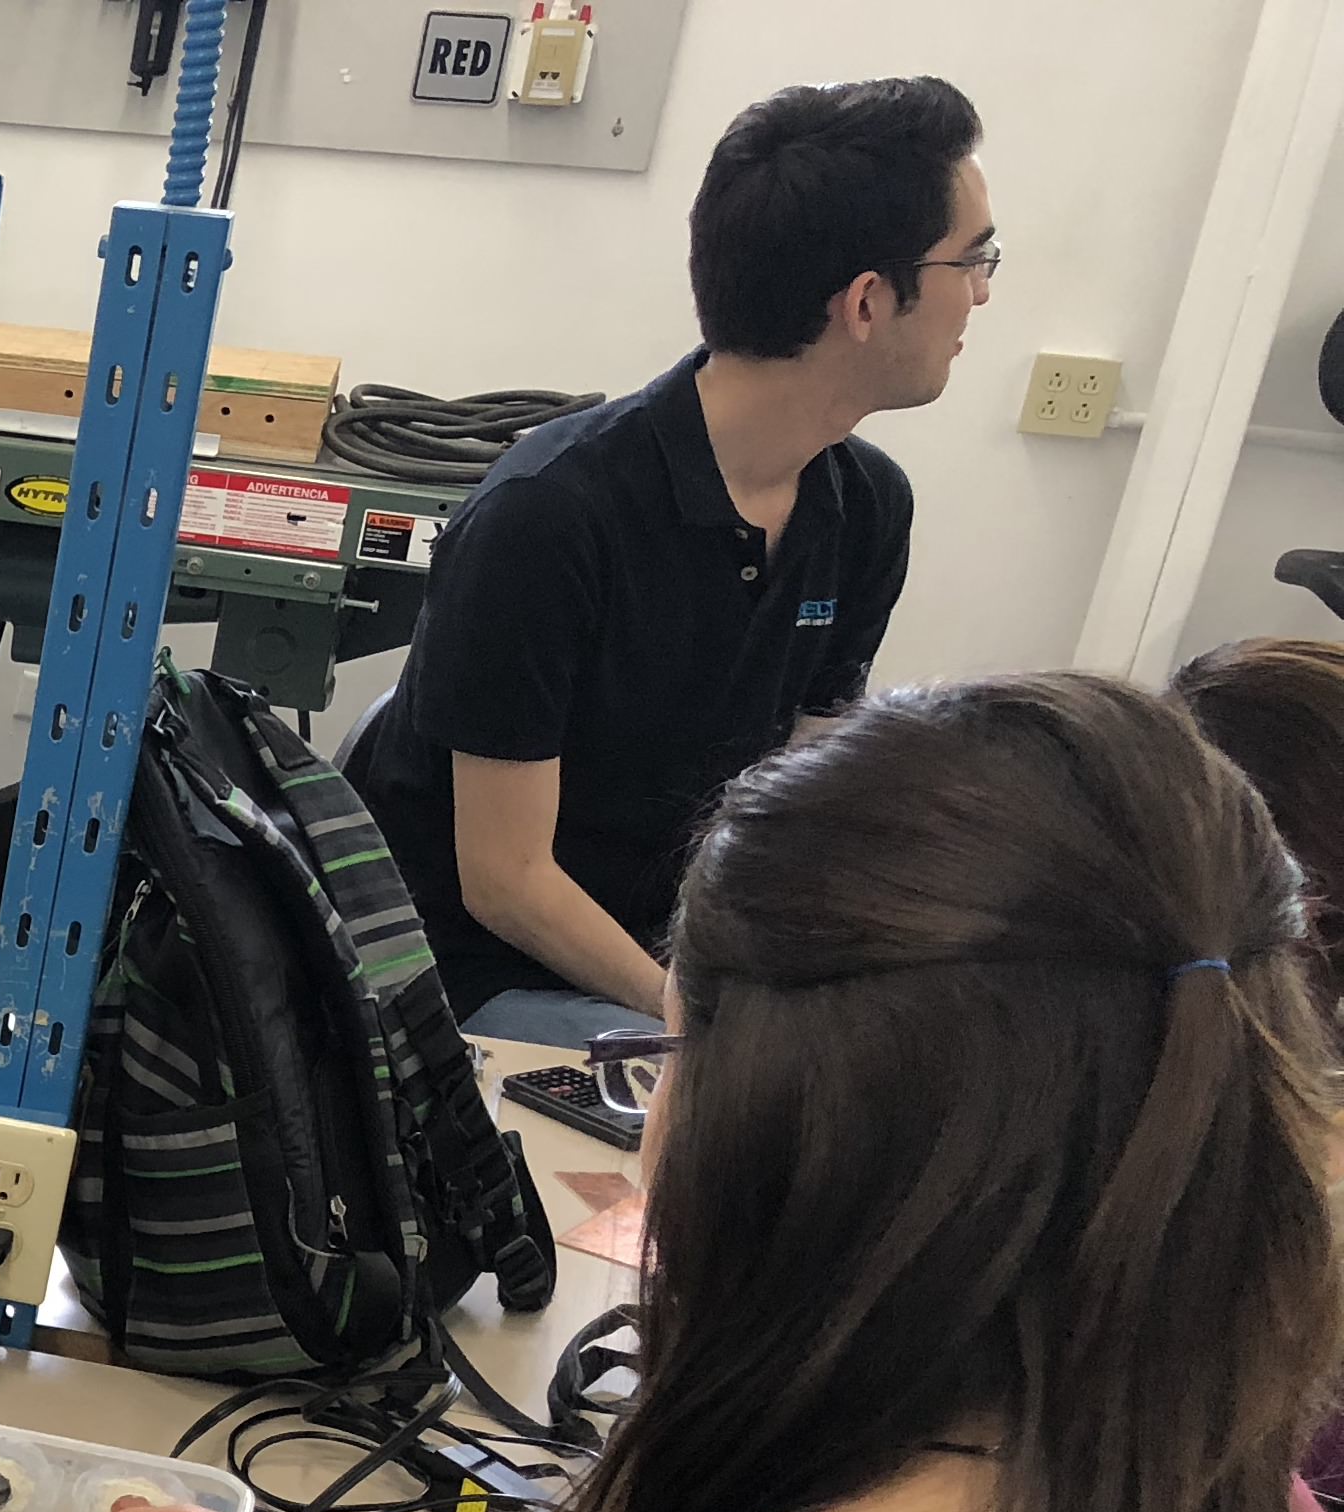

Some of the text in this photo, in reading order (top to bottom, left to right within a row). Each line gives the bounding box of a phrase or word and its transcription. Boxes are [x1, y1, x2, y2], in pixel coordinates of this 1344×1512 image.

[428, 37, 492, 77] RED
[16, 487, 70, 504] HYTR
[246, 481, 330, 501] ADVERTENCIA
